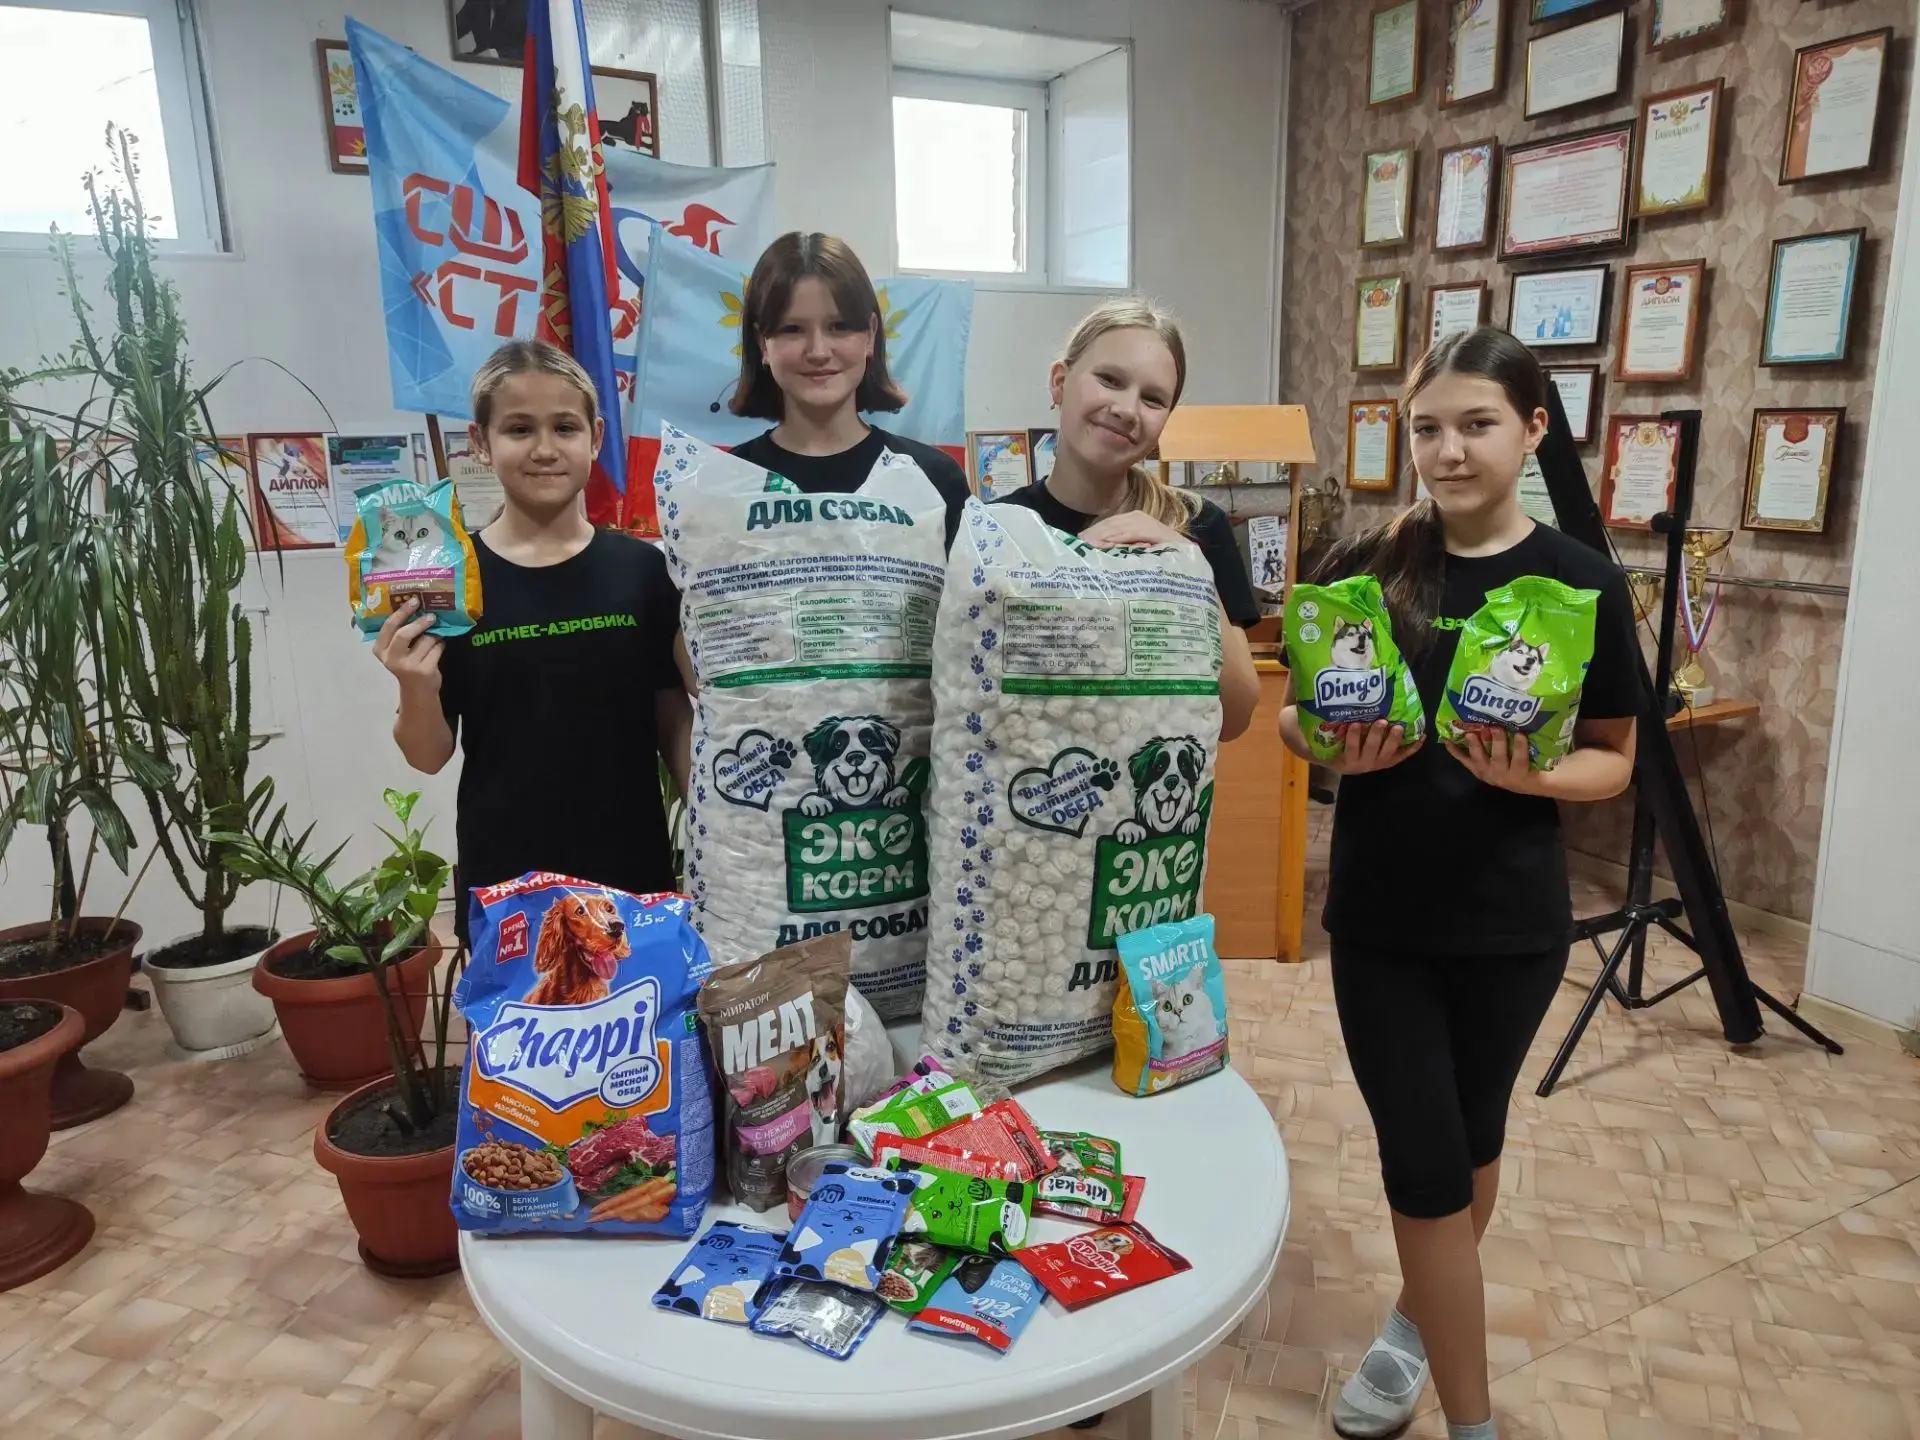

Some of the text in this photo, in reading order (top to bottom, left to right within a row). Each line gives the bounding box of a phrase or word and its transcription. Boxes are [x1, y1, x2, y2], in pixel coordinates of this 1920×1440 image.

[1641, 296, 1680, 306] ДИПЛОМ
[269, 478, 328, 492] ДИПЛОМ
[747, 499, 914, 531] ДЛЯ СОБАК
[697, 564, 740, 579] ХРУСТЯЩИЕ
[780, 555, 854, 567] ИЗГОТОВЛЕННЫЕ
[772, 566, 820, 577] СОДЕРЖАТ
[822, 565, 885, 573] НЕОБХОДИМЫЕ
[707, 584, 750, 597] МИНЕРАЛЫ
[758, 577, 807, 589] ВИТАМИНЫ
[816, 575, 855, 583] НУЖНОМ
[471, 614, 638, 647] ФИТНЕС-АЭРОБИКА
[1320, 672, 1381, 703] Dingo
[1329, 708, 1352, 718] КОРМ
[1466, 685, 1533, 719] Dingo
[743, 769, 786, 800] ОБЕД
[1051, 790, 1104, 826] ОБЕД
[801, 813, 914, 865] ЭКО
[802, 860, 914, 901] КОРМ
[1108, 840, 1199, 897] ЭКО
[1102, 893, 1190, 937] КОРМ
[776, 920, 841, 949] ДЛЯ
[720, 991, 770, 1018] МИРАТОРГ
[722, 990, 817, 1076] MEAT
[984, 1029, 1028, 1042] МЕТОДОМ
[999, 1022, 1053, 1032] ХРУСТЯЩИЕ
[478, 1000, 650, 1079] Chappi
[610, 1064, 649, 1080] СЫТНЫЙ
[610, 1075, 649, 1090] МЯСНОЙ
[617, 1086, 642, 1097] ОБЕД
[463, 1183, 501, 1210] 100%
[513, 1202, 559, 1211] ВИТАМИНЫ
[818, 1188, 842, 1203] 100
[857, 1196, 890, 1206] КУРИЦЕЙ
[708, 1237, 731, 1250] 100
[939, 1314, 980, 1335] ГОВЯДИНА
